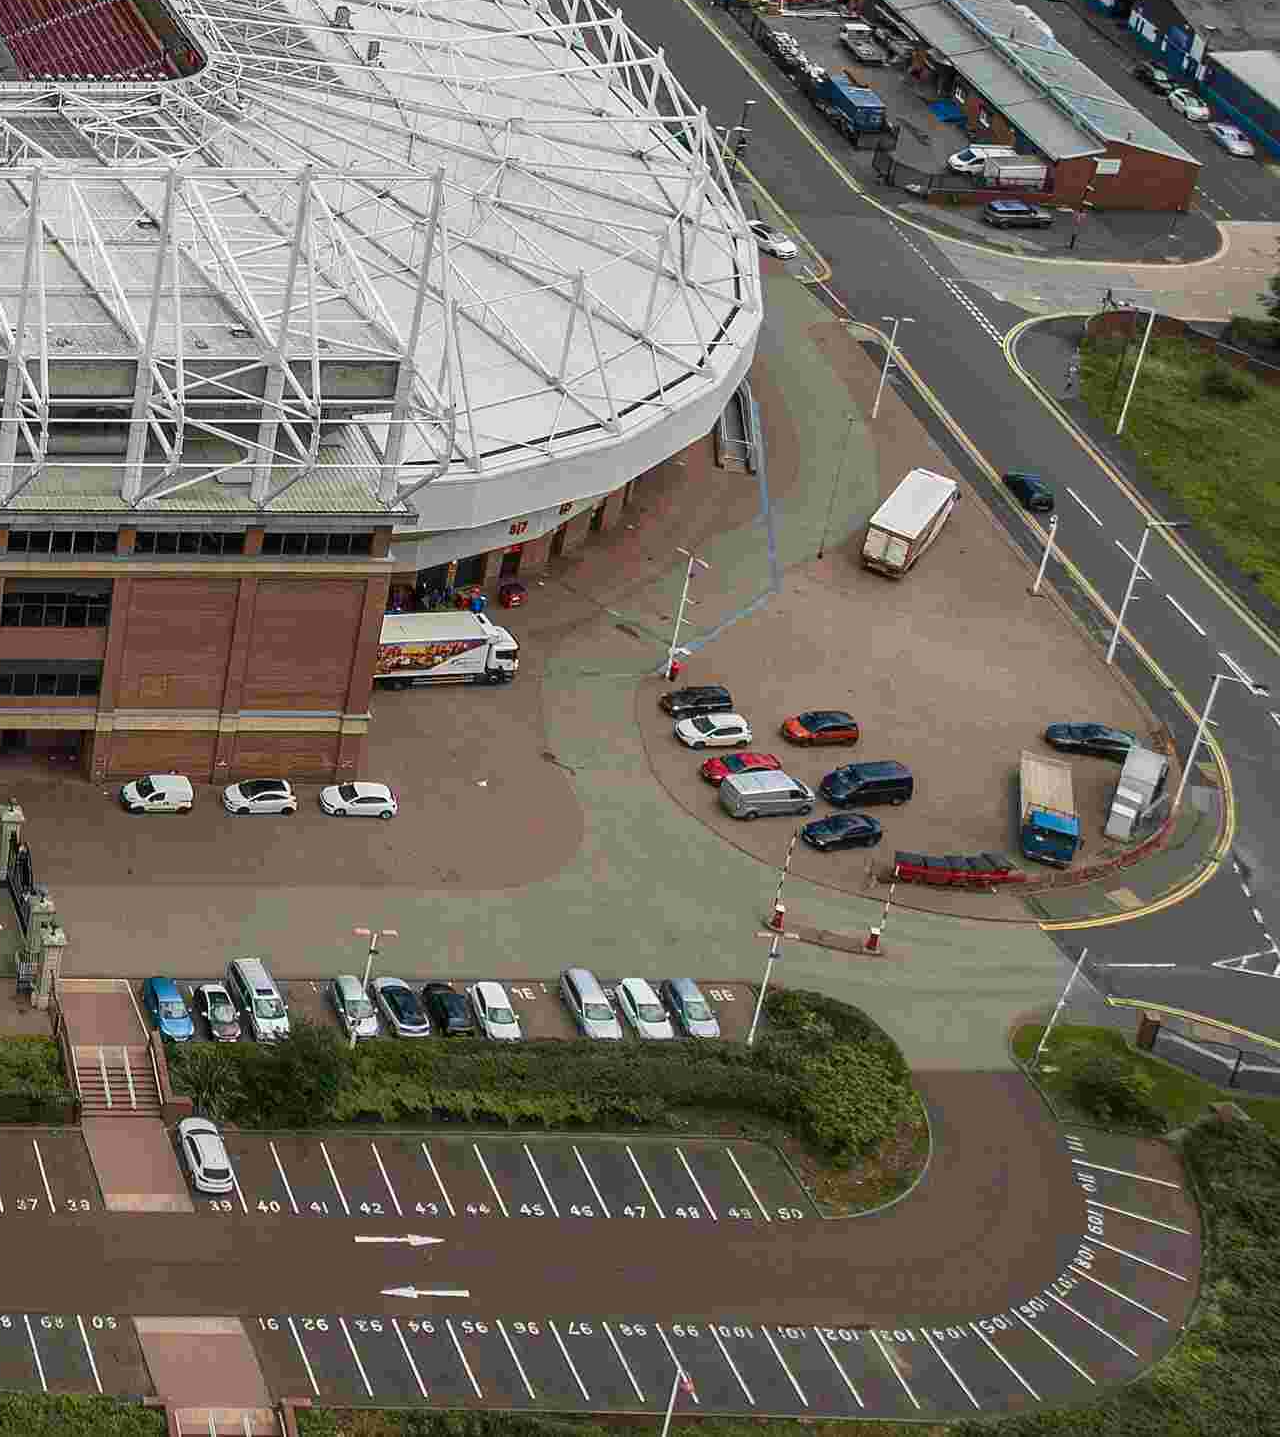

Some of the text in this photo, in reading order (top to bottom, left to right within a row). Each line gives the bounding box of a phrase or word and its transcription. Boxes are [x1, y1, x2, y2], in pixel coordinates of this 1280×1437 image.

[1064, 1134, 1086, 1152] 111
[1077, 1172, 1096, 1192] 110
[209, 1201, 232, 1211] 39
[256, 1201, 280, 1211] 40
[360, 1203, 384, 1213] 42
[415, 1203, 438, 1214] 43
[520, 1204, 544, 1216] 45
[570, 1205, 593, 1217] 46
[623, 1206, 646, 1217] 47
[675, 1206, 699, 1217] 48
[1087, 1210, 1104, 1235] 109
[1074, 1244, 1096, 1269] 108
[1020, 1296, 1048, 1318] 106
[258, 1318, 279, 1330] 91
[302, 1318, 328, 1330] 92
[408, 1321, 434, 1332] 94
[462, 1321, 488, 1333] 95
[513, 1322, 539, 1334] 96
[568, 1323, 592, 1334] 97
[979, 1313, 1013, 1333] 105
[673, 1325, 699, 1336] 99
[719, 1326, 753, 1338] 100
[823, 1329, 860, 1341] 102
[933, 1325, 967, 1341] 104
